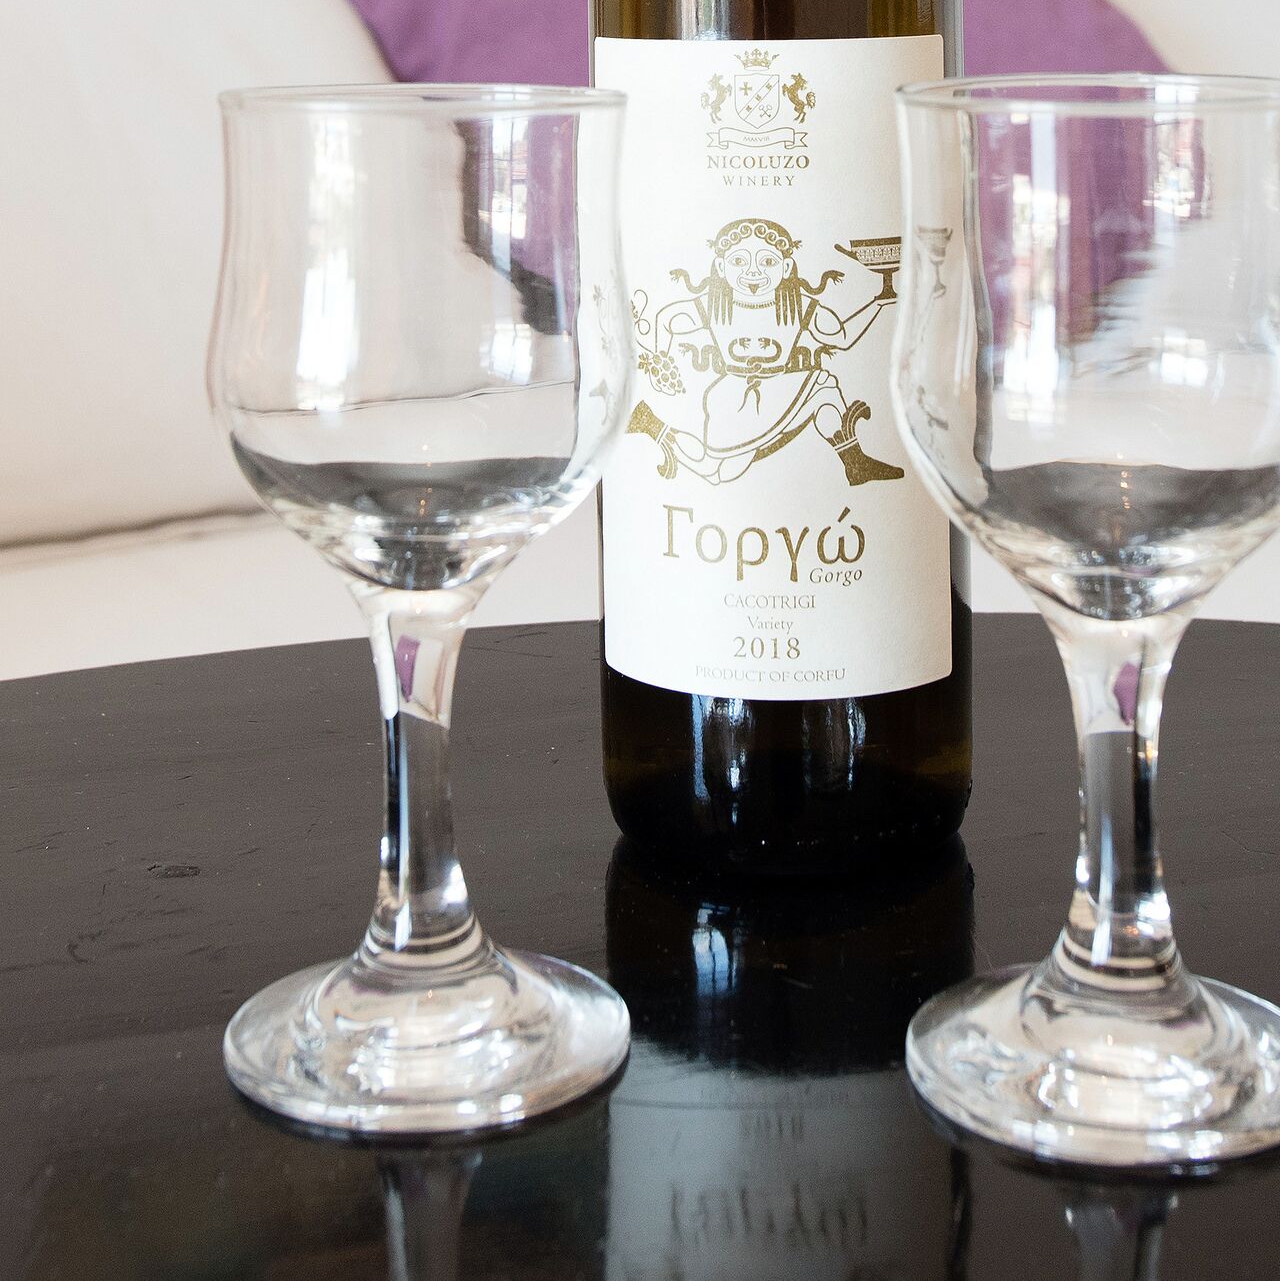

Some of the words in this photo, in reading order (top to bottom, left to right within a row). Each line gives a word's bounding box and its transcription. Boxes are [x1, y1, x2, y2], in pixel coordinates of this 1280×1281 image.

[706, 155, 810, 169] NICOLUZO
[722, 175, 795, 186] WINERY
[662, 504, 866, 582] Γοργώ
[809, 567, 864, 587] Gorgo
[723, 593, 816, 609] CACOTRIGI
[746, 615, 795, 635] Variety
[732, 635, 801, 660] 2018
[695, 664, 766, 683] PRODUCT
[768, 669, 791, 683] OF
[793, 667, 847, 683] CORFU
